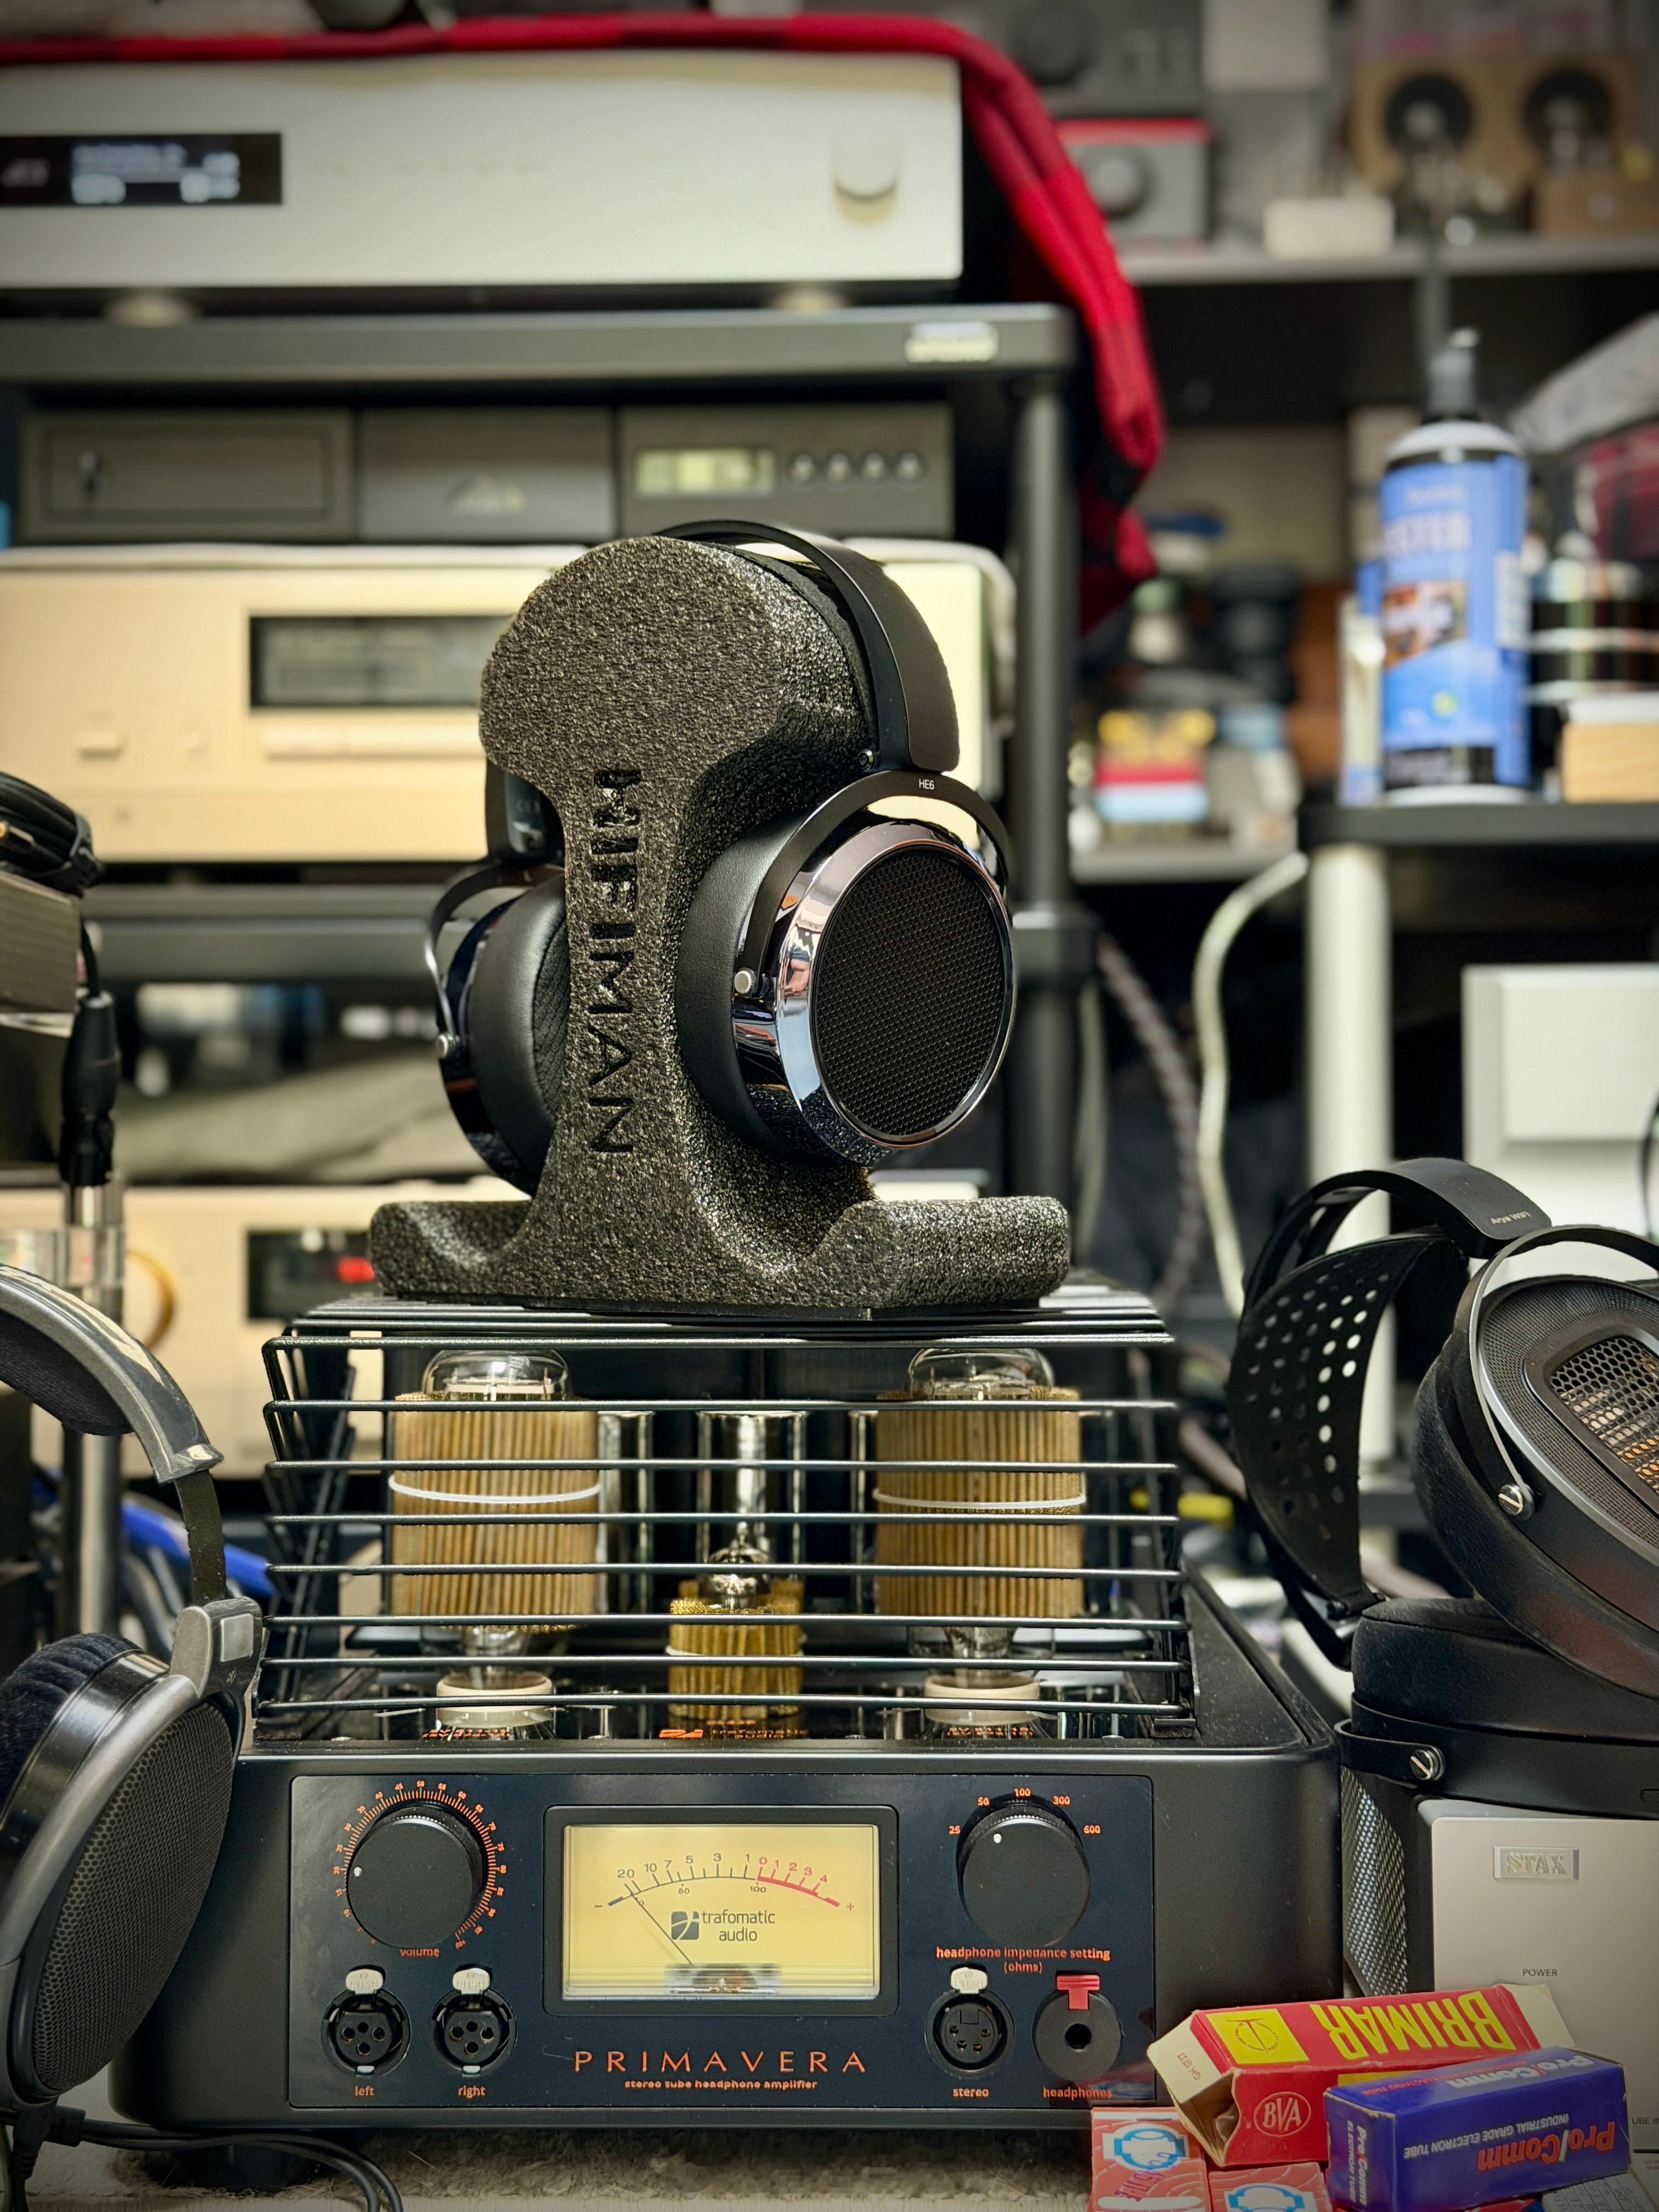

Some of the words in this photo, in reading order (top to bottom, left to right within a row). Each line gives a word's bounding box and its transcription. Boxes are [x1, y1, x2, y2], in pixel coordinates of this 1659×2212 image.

[918, 778, 935, 790] HE6
[588, 769, 641, 1152] HIFIMAN
[375, 1791, 383, 1799] 40
[1014, 1787, 1031, 1797] 100
[977, 1797, 990, 1807] 50
[1053, 1796, 1070, 1805] 300
[357, 1804, 366, 1814] 35
[343, 1822, 352, 1832] 30
[488, 1821, 496, 1831] 70
[949, 1826, 961, 1835] 25
[1083, 1825, 1101, 1835] 600
[336, 1843, 343, 1853] 25
[617, 1869, 635, 1878] 20
[644, 1863, 657, 1872] 10
[664, 1859, 673, 1869] 7
[685, 1855, 694, 1864] 5
[713, 1853, 722, 1862] 3
[744, 1853, 751, 1862] 1
[759, 1856, 768, 1865] 0
[774, 1859, 780, 1869] 1
[788, 1862, 798, 1872] 2
[804, 1866, 812, 1876] 3
[819, 1874, 828, 1883] 4
[1505, 1851, 1568, 1875] STAX
[333, 1866, 340, 1875] 20
[701, 1909, 776, 1924] trafomatic
[719, 1926, 758, 1942] audio
[399, 1948, 439, 1957] volume
[936, 1946, 1001, 1960] headphone
[1003, 1946, 1067, 1961] impedance
[1069, 1947, 1111, 1961] setting
[1003, 1961, 1043, 1974] (ohms)
[1521, 1968, 1558, 1977] POWER
[349, 1980, 379, 1989] PUSH
[1309, 1991, 1517, 2060] BRIMAR
[574, 2050, 866, 2073] PRIMAVERA
[1446, 2055, 1594, 2088] Pro/Comm
[354, 2085, 374, 2097] left
[458, 2085, 486, 2098] right
[624, 2080, 662, 2089] stereo
[664, 2079, 692, 2089] tube
[695, 2079, 761, 2090] headphone
[764, 2079, 818, 2091] amplifier
[952, 2087, 989, 2098] stereo
[1042, 2086, 1113, 2100] headphones
[1262, 2097, 1302, 2134] BVA
[1516, 2112, 1570, 2132] INDUSTRIAL
[1631, 2116, 1651, 2125] UBE
[1482, 2125, 1514, 2141] GRADE
[1347, 2119, 1356, 2175] ELECTRON
[1431, 2132, 1481, 2152] ELECTRON
[1476, 2120, 1616, 2172] Pro/Comm
[1403, 2144, 1429, 2160] TUBE
[1356, 2124, 1368, 2207] Pro/Comm
[1348, 2175, 1357, 2203] TUBE
